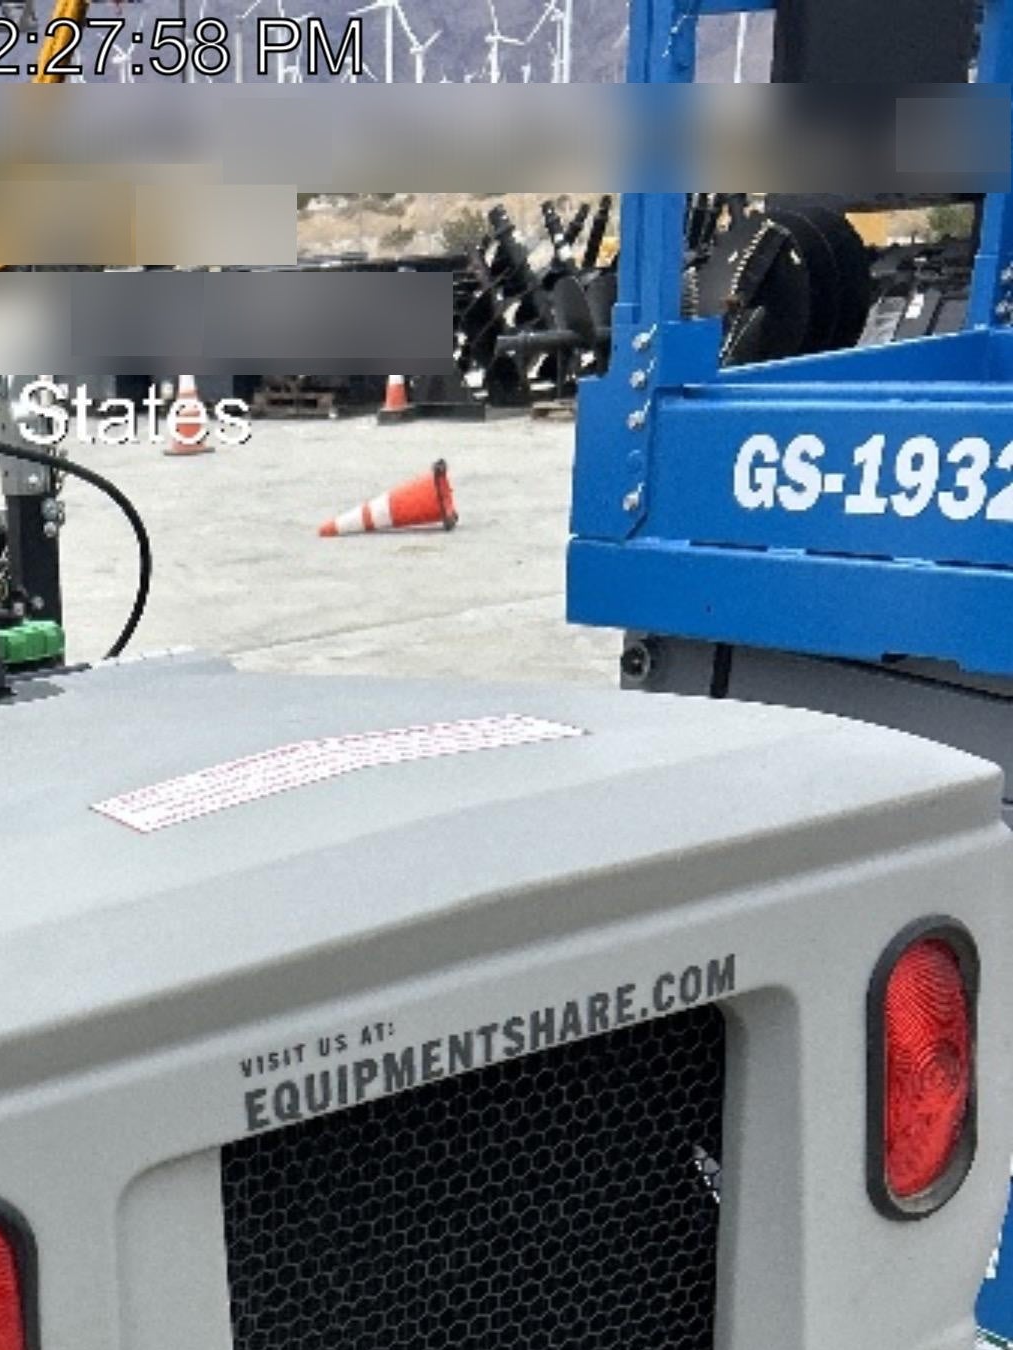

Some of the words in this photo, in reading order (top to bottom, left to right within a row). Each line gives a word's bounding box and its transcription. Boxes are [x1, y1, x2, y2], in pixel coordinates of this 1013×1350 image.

[733, 433, 1013, 521] GS-1932
[240, 1043, 306, 1078] VISIT
[319, 1034, 348, 1058] US
[360, 1021, 396, 1046] AT:
[244, 953, 736, 1132] EQUIPMENTSHARE.COM
